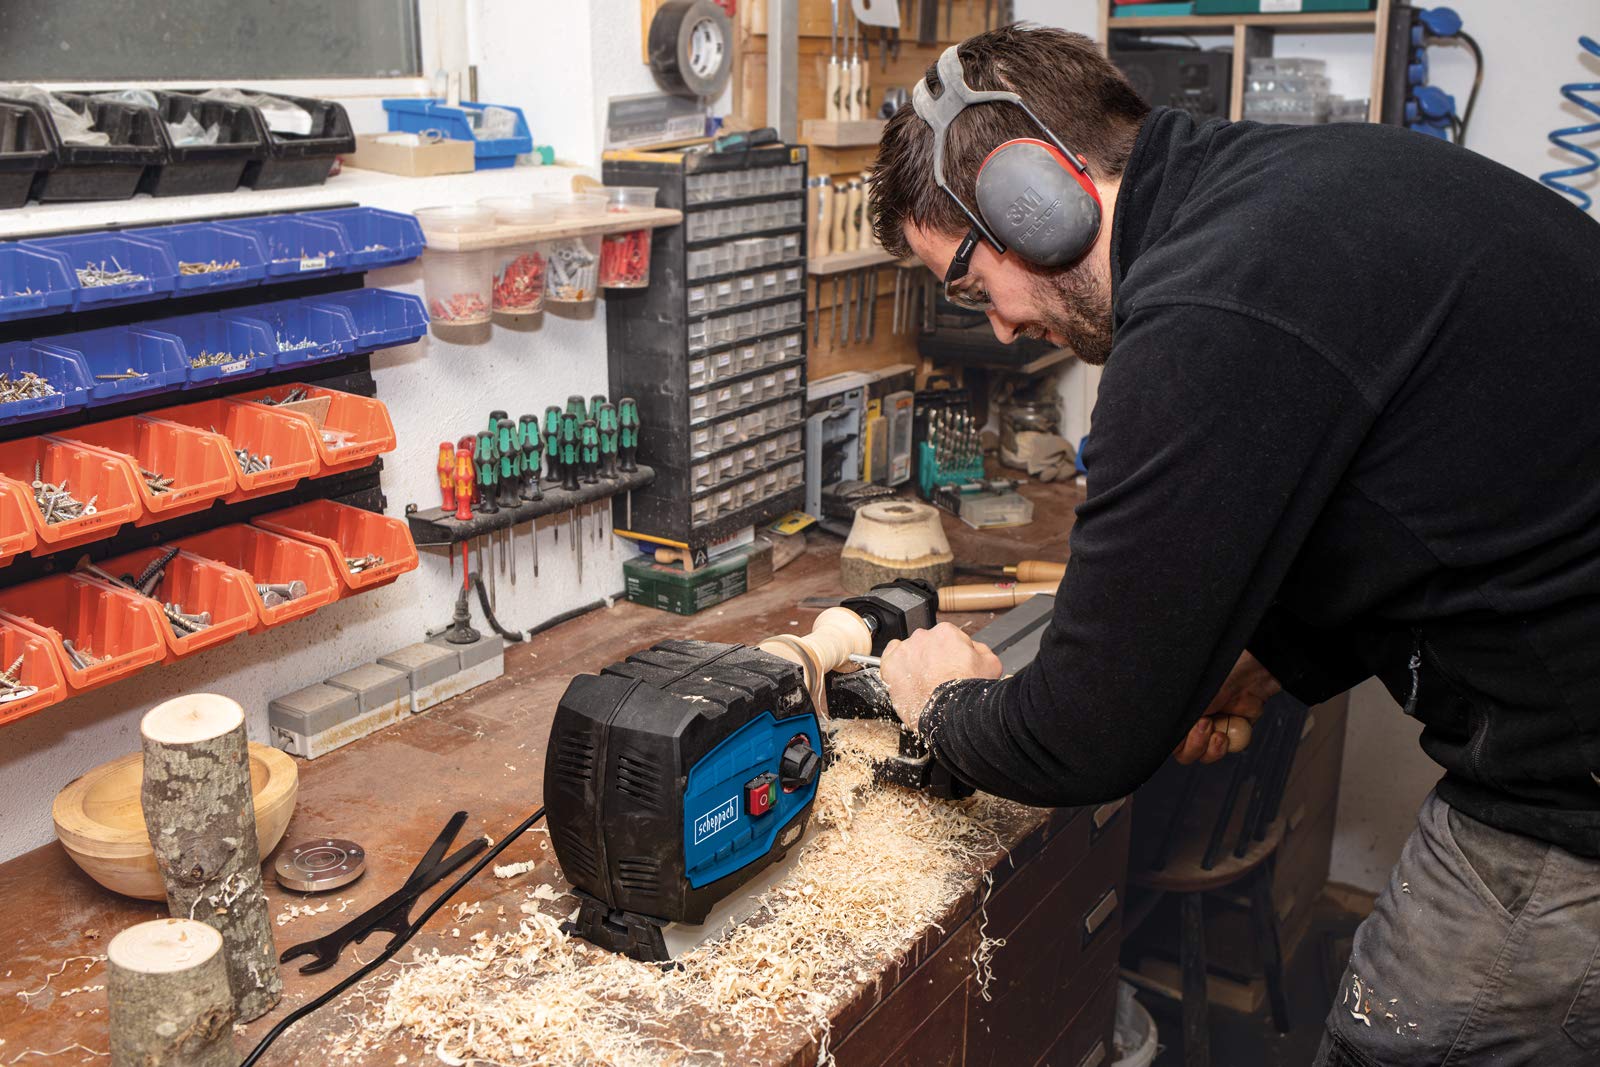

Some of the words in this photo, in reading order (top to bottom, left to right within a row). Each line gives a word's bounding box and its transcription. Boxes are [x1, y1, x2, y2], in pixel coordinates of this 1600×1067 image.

[1007, 187, 1043, 226] 3M
[1018, 199, 1062, 244] PELTOR
[698, 799, 734, 837] scheppach
